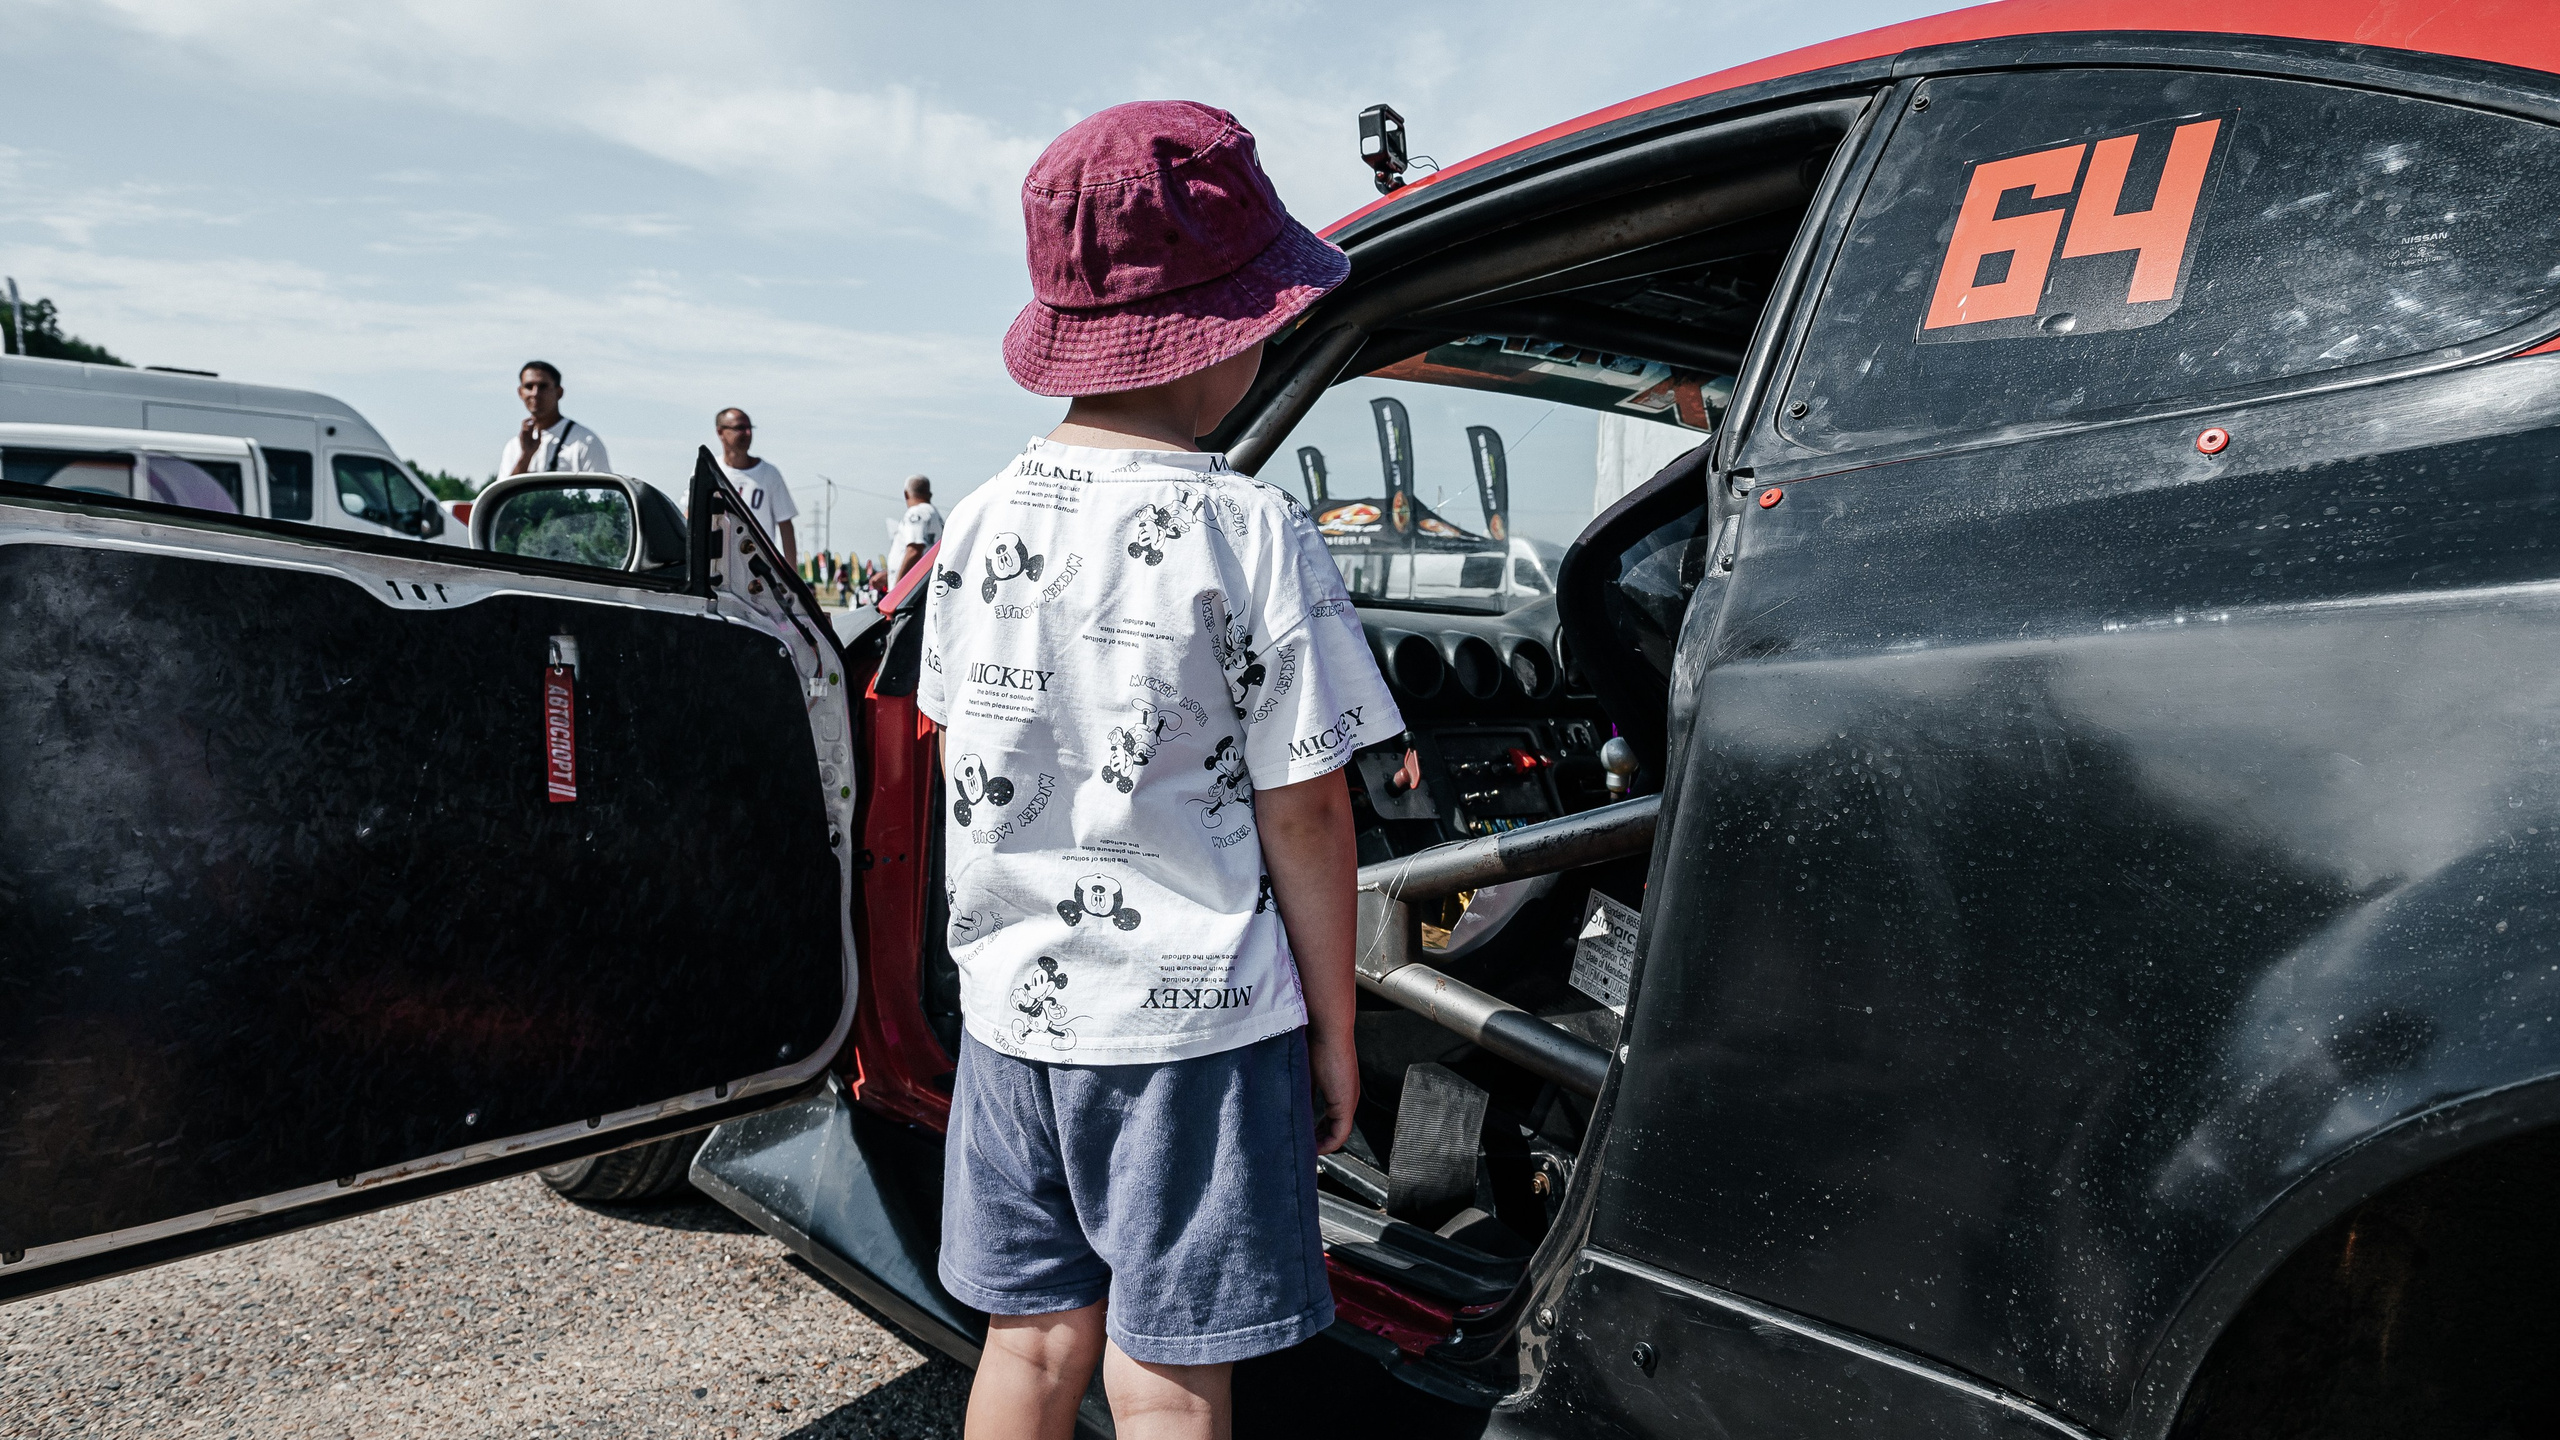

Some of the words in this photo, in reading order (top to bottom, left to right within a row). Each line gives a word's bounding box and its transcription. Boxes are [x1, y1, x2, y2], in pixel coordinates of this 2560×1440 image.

[1923, 117, 2222, 331] 64
[2401, 232, 2448, 244] NISSAN
[1219, 494, 1249, 537] MOUSE
[1042, 553, 1083, 602] MICKEY
[1082, 634, 1107, 644] solitude
[1156, 634, 1174, 642] heart
[967, 662, 1054, 692] MICKEY
[1277, 644, 1296, 696] MICKEY
[1130, 674, 1178, 698] MICKEY
[979, 700, 991, 708] with
[992, 702, 1021, 712] pleasure
[1010, 693, 1034, 702] solitude
[981, 711, 992, 720] with
[994, 712, 1004, 721] the
[548, 684, 572, 782] АВТОСПОРТ
[1288, 706, 1364, 762] MICKEY
[1314, 766, 1332, 776] heart
[1332, 760, 1346, 769] with
[1322, 754, 1334, 763] the
[1016, 773, 1055, 827] MICKEY
[1096, 846, 1126, 854] pleasure
[1602, 901, 1625, 922] Standard
[1589, 909, 1637, 946] bimarc
[1586, 950, 1598, 964] Date
[1598, 957, 1604, 968] of
[1616, 941, 1635, 960] Expert
[1140, 985, 1252, 1010] MICKEY
